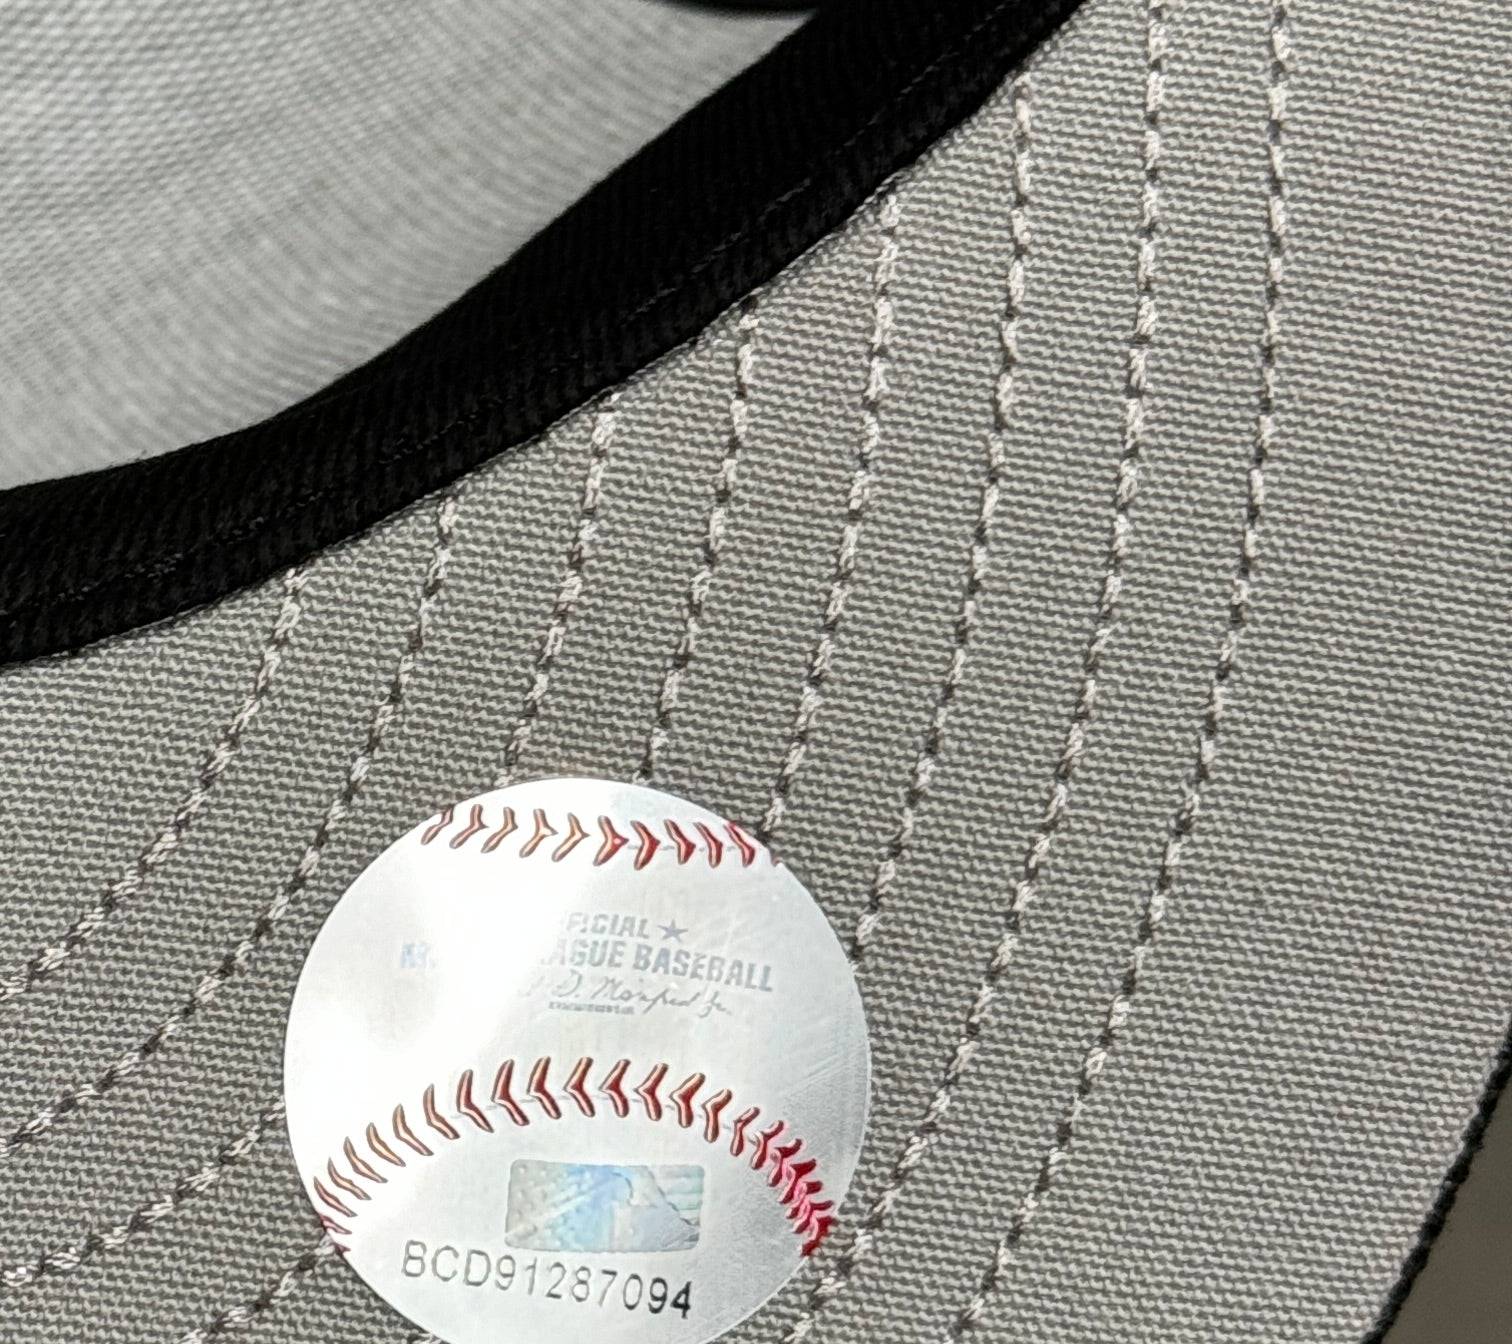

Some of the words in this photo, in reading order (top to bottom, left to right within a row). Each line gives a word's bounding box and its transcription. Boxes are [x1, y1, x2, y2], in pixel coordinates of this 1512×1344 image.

[565, 912, 650, 939] FICIAL
[633, 943, 773, 992] BASEBALL
[401, 1239, 692, 1319] BCD91287094
